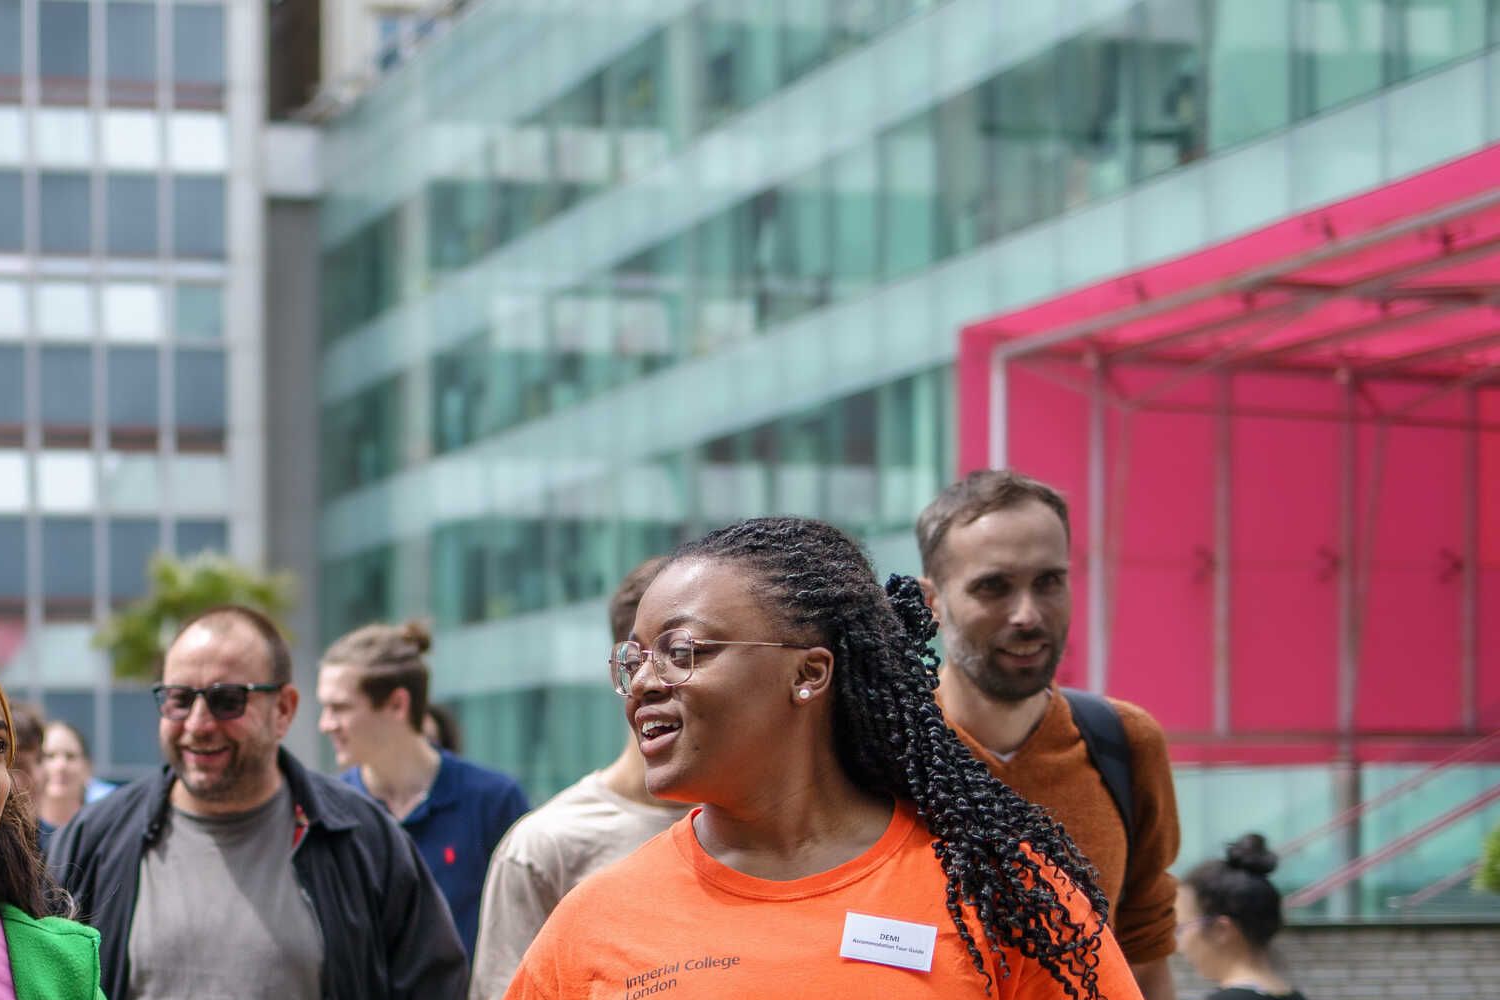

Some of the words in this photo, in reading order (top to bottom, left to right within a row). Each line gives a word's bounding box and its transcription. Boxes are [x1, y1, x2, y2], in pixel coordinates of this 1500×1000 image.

[879, 933, 900, 943] DEMI
[626, 961, 679, 990] Imperial
[685, 955, 741, 974] College
